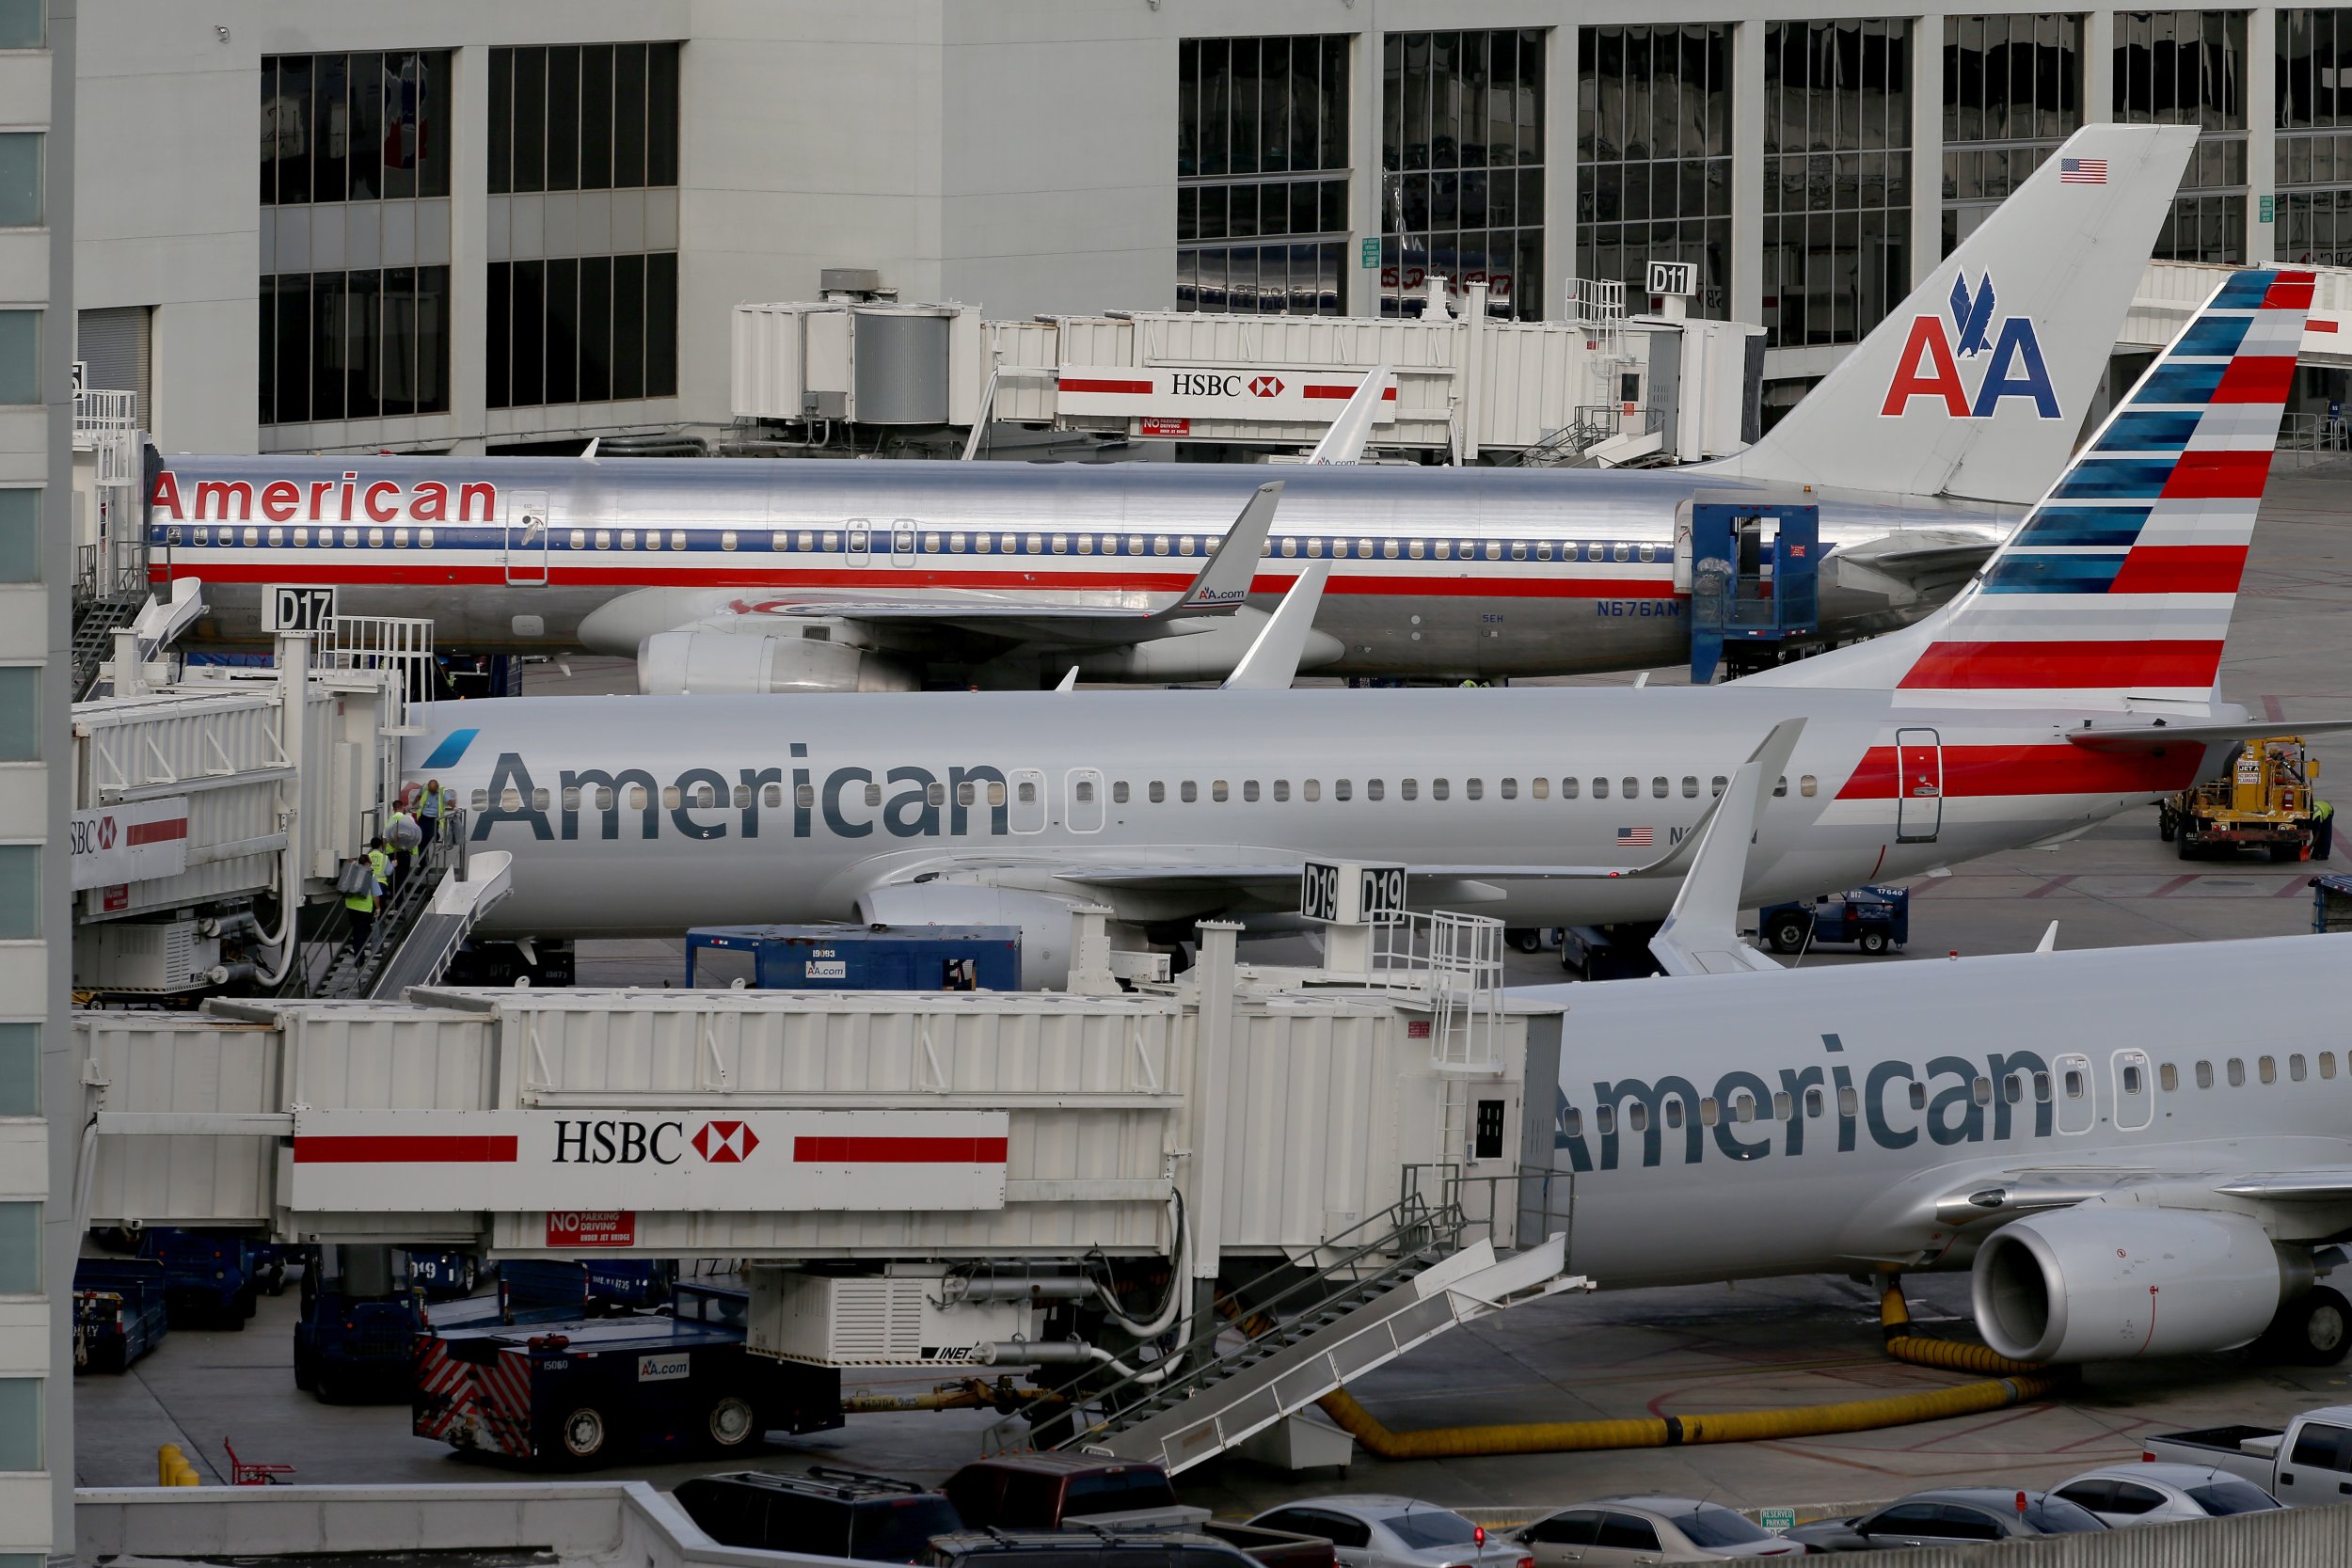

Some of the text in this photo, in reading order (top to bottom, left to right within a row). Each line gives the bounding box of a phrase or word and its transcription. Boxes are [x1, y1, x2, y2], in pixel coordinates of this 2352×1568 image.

[1653, 265, 1685, 293] D11
[1880, 314, 2063, 420] AA
[1171, 374, 1241, 397] HSBC
[1144, 419, 1159, 428] NO
[151, 471, 495, 523] American
[1199, 587, 1245, 599] AA.com
[278, 590, 331, 629] D17
[1597, 600, 1679, 617] N676AN
[469, 742, 1008, 841] American
[1305, 865, 1402, 922] D19 D19
[812, 949, 835, 958] 19093
[807, 966, 844, 975] AA.com
[552, 1120, 683, 1165] HSBC
[550, 1212, 620, 1232] NO PARKING
[580, 1222, 617, 1231] DRIVING
[611, 1233, 630, 1242] BRIDGE
[938, 1346, 973, 1360] INET
[642, 1363, 687, 1376] AA.com
[1762, 1509, 1793, 1518] RESERVED
[1766, 1518, 1790, 1528] PARKING
